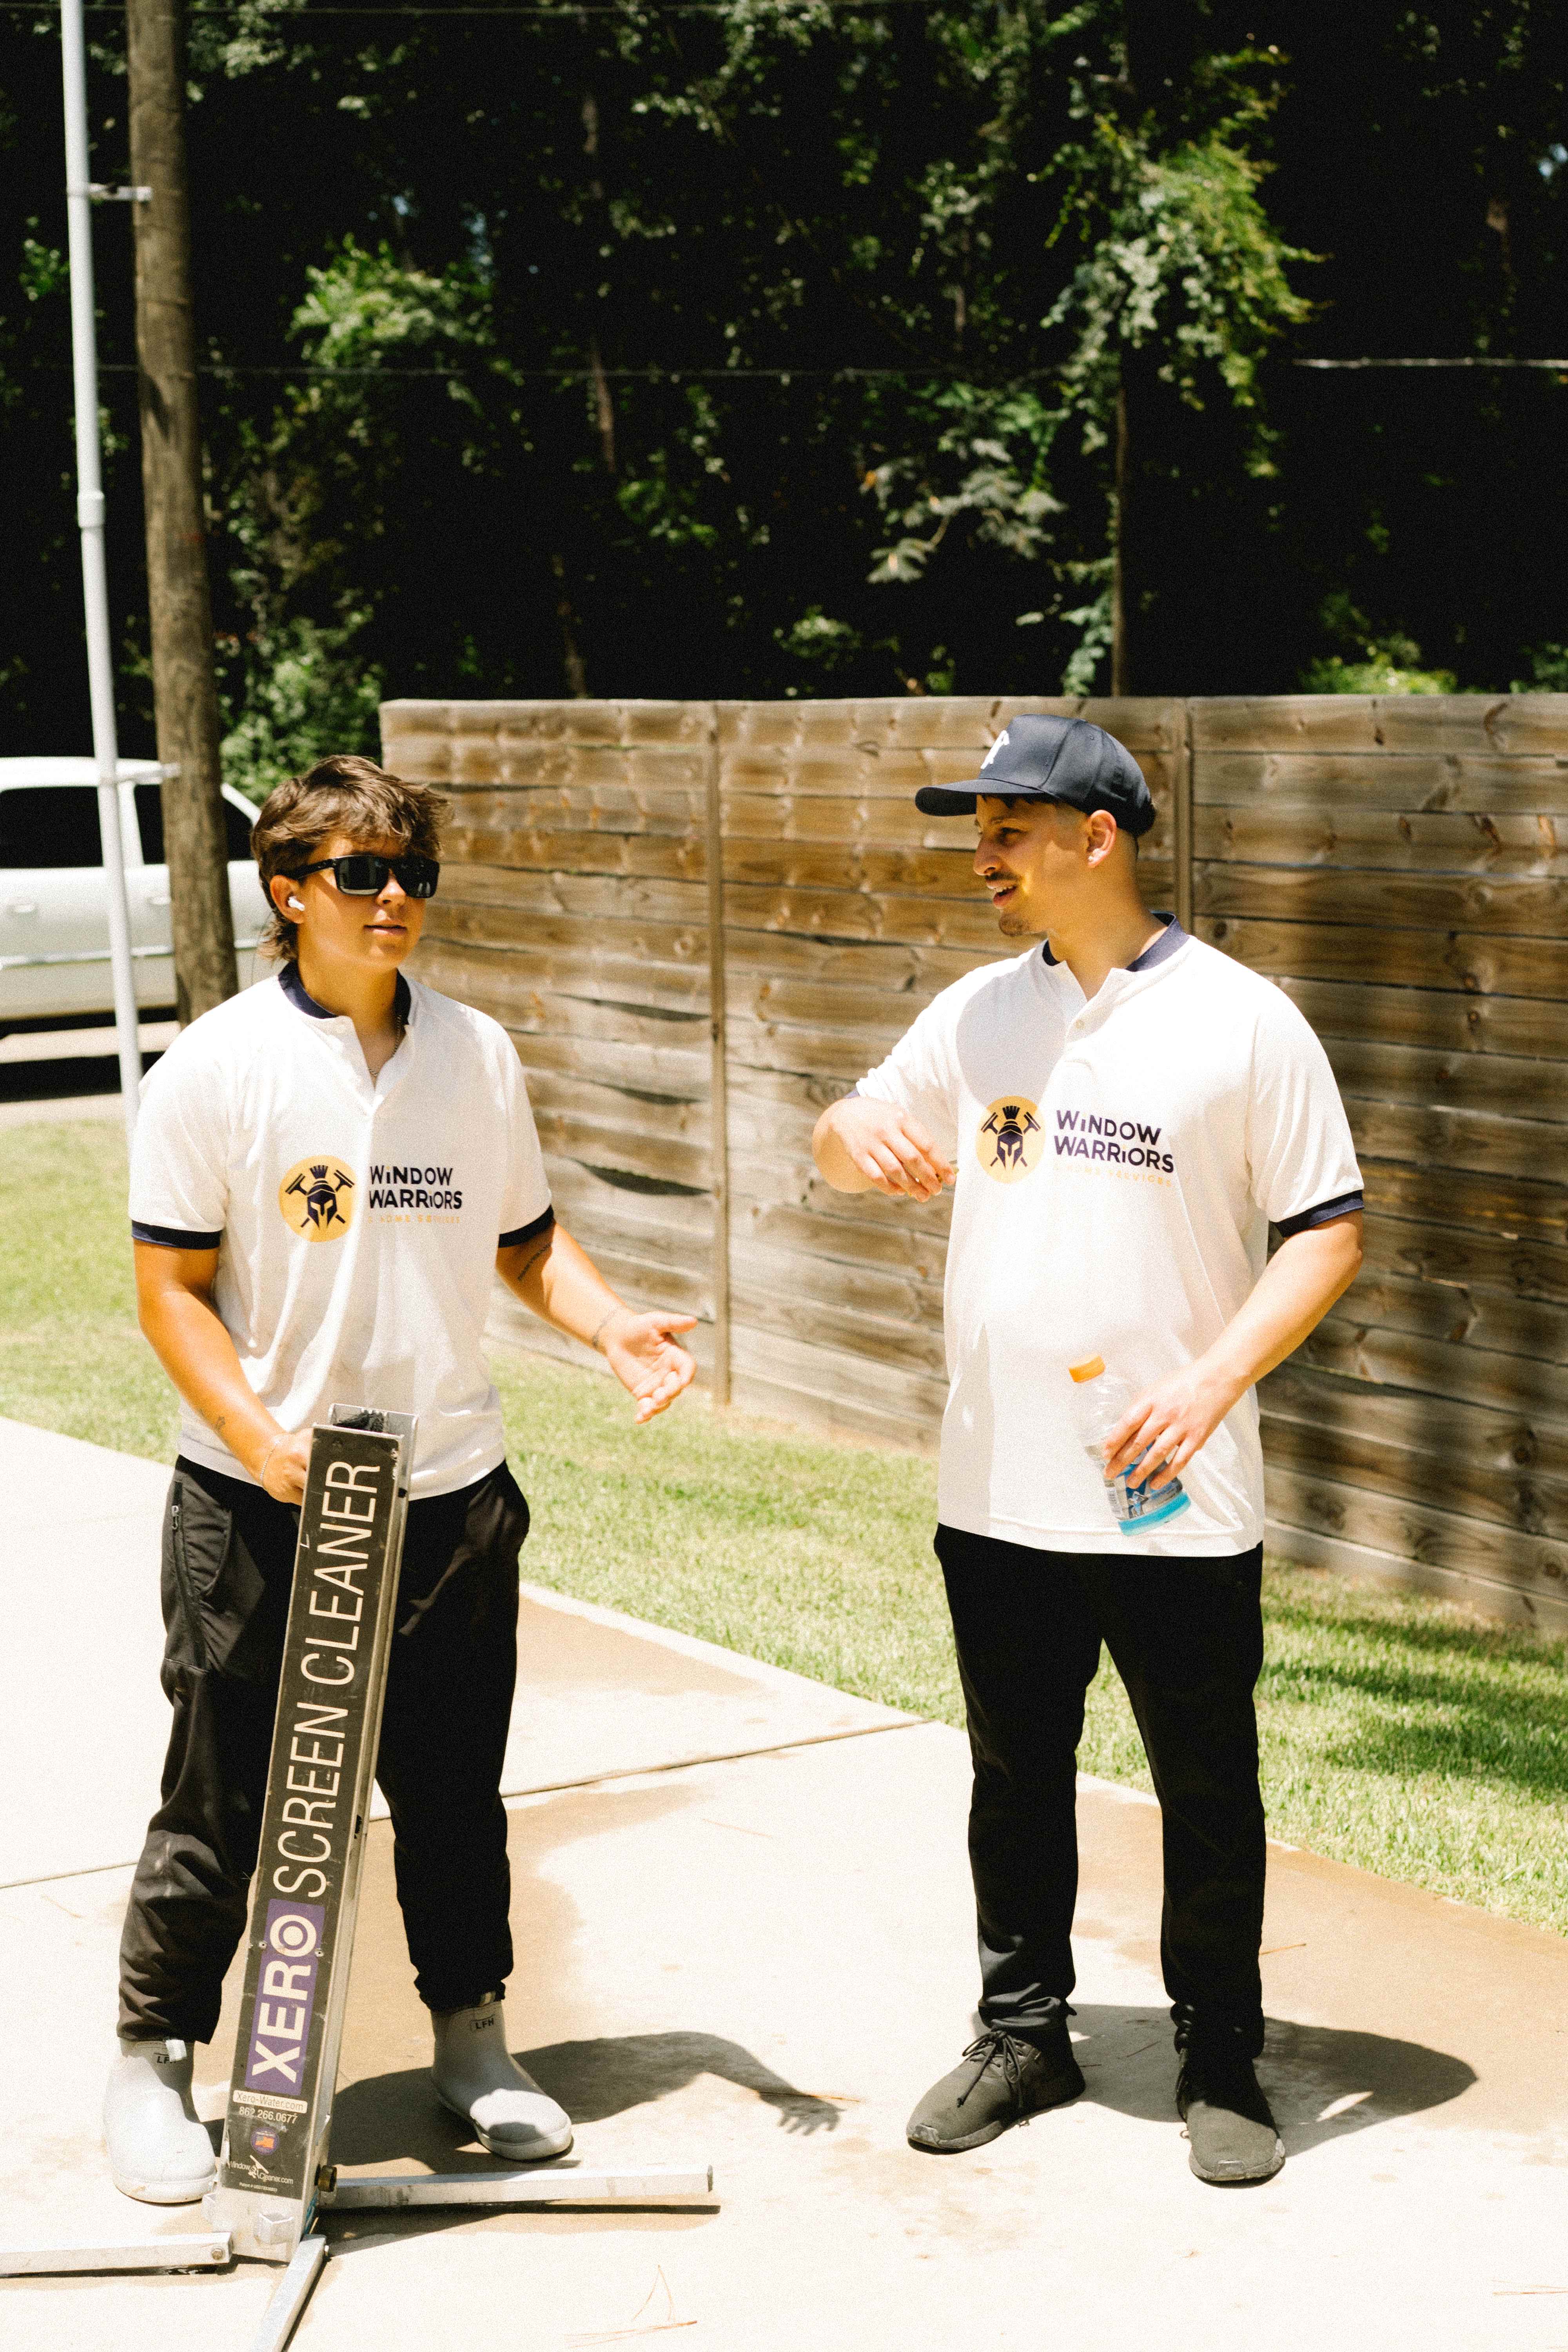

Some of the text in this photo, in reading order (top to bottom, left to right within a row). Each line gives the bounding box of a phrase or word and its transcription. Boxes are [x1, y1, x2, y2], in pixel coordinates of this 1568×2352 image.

[252, 1461, 380, 2083] XERO SCREEN CLEANER
[237, 2092, 303, 2111] Xero-Water.com
[239, 2106, 298, 2124] 862.266.0677
